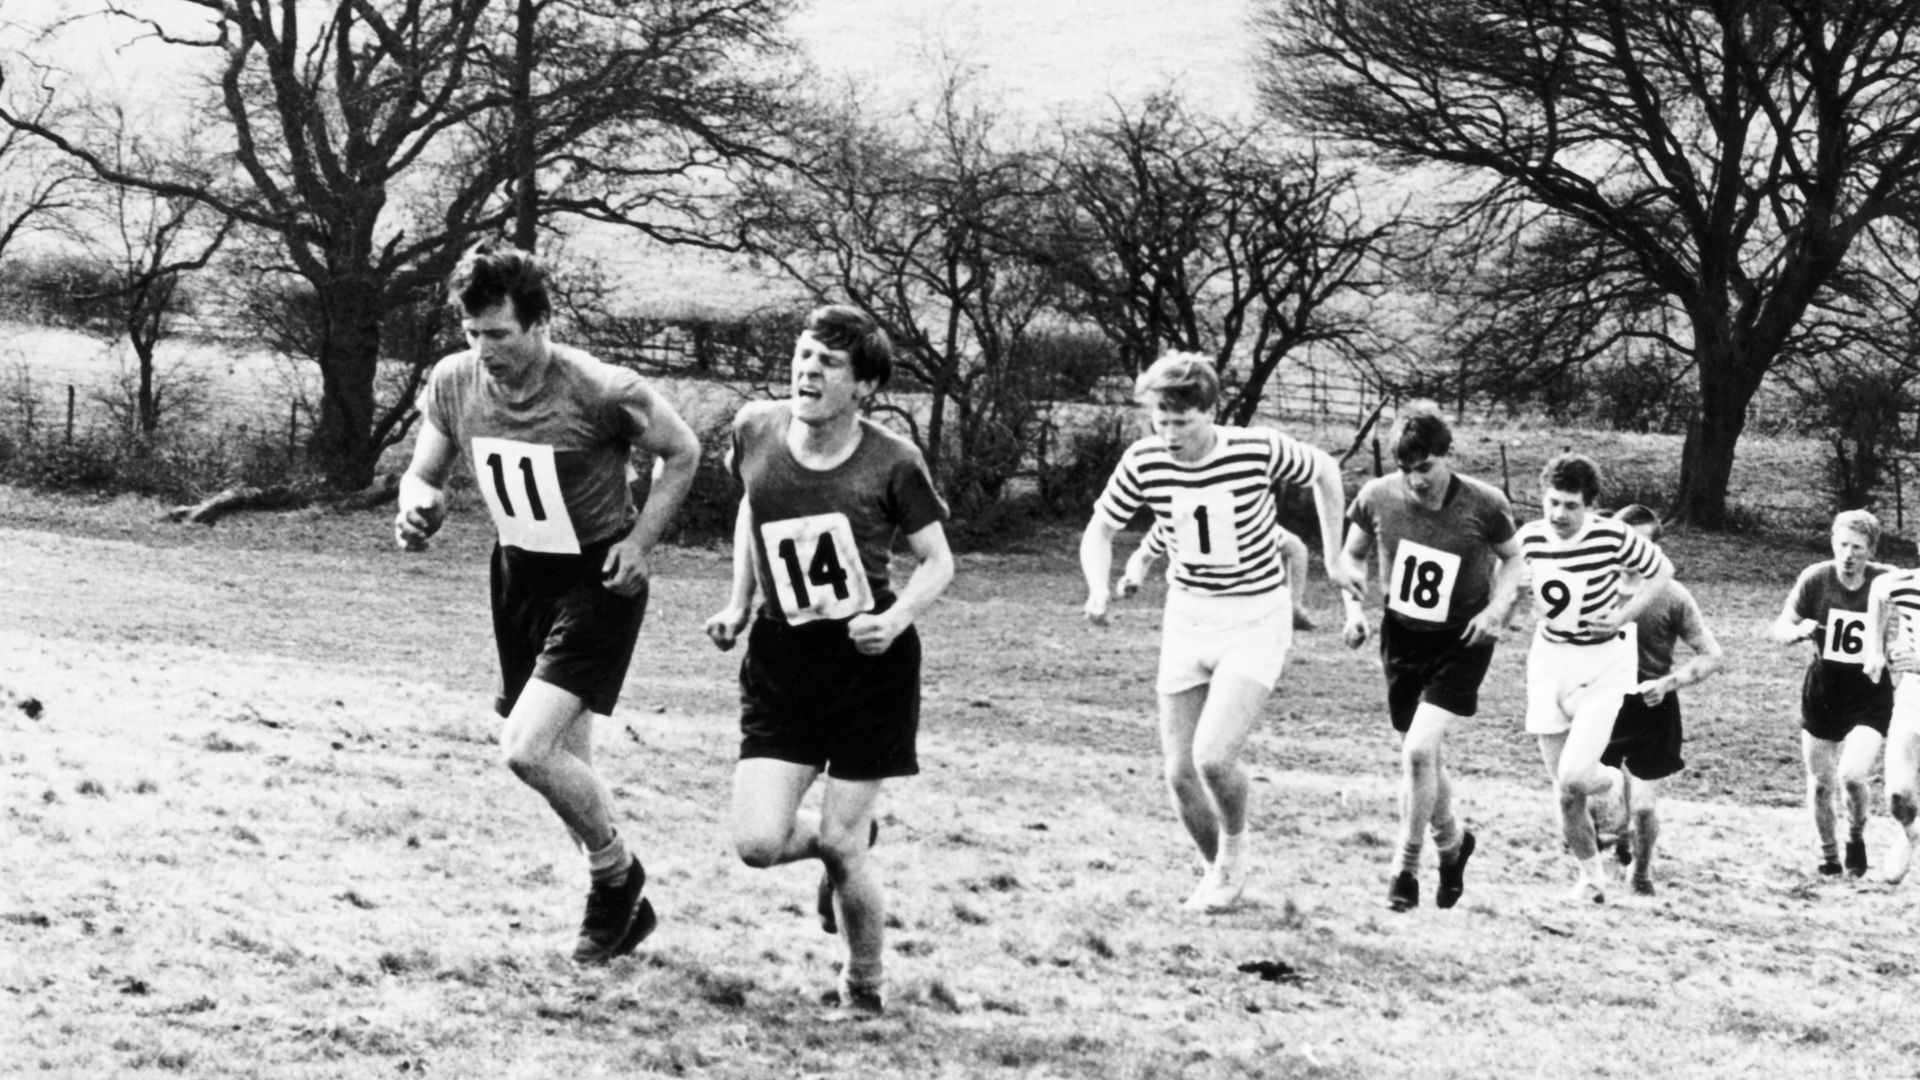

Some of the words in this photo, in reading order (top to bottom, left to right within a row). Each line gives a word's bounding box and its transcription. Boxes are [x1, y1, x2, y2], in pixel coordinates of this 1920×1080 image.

[487, 453, 547, 521] 11
[1193, 505, 1211, 554] 1
[779, 531, 849, 609] 14
[1400, 555, 1444, 608] 18
[1541, 580, 1571, 619] 9
[1832, 618, 1865, 654] 16
